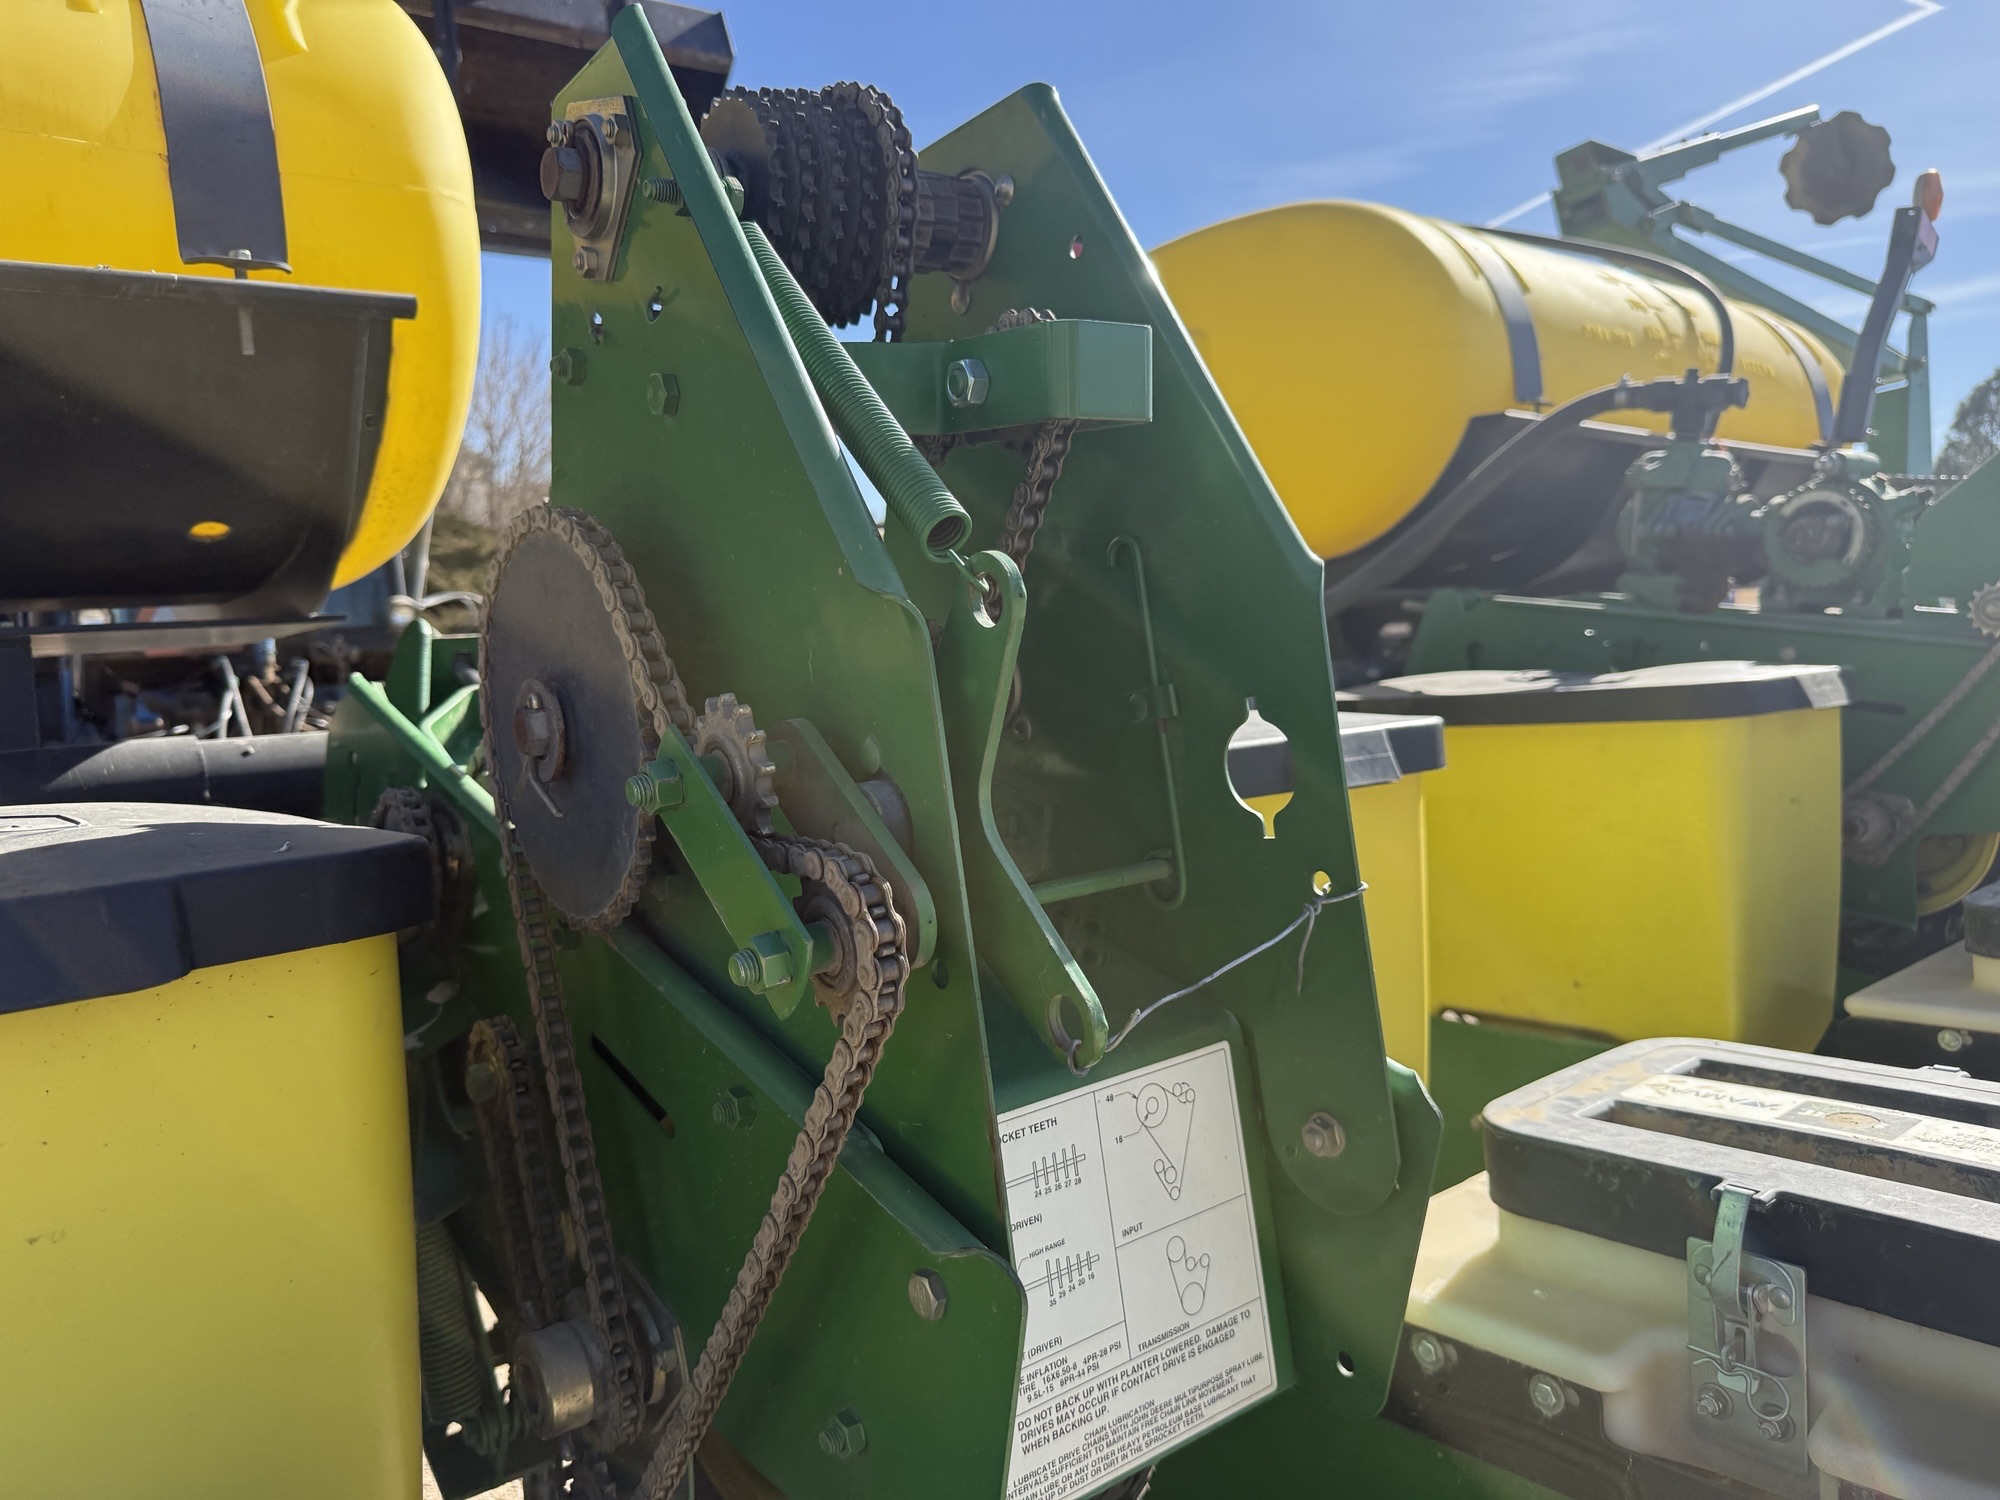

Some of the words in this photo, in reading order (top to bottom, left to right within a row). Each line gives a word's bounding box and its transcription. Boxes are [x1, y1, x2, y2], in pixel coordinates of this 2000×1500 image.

[1106, 1094, 1114, 1102] 48
[1002, 1128, 1026, 1143] CKET
[1028, 1117, 1057, 1134] TEETH
[1116, 1135, 1123, 1144] 18
[1034, 1190, 1042, 1198] 24
[1055, 1183, 1062, 1191] 26
[1065, 1180, 1071, 1188] 27
[1074, 1177, 1082, 1185] 28
[1010, 1213, 1042, 1232] DRIVEN)
[1122, 1222, 1143, 1237] INPUT
[1029, 1247, 1044, 1258] HIGH
[1045, 1238, 1065, 1251] RANGE
[1050, 1299, 1057, 1307] 35
[1059, 1290, 1066, 1298] 29
[1068, 1284, 1075, 1292] 24
[1078, 1278, 1085, 1286] 20
[1088, 1272, 1094, 1280] 16
[1028, 1336, 1062, 1359] (DRIVER)
[1138, 1321, 1190, 1352] TRANSMISSION
[1018, 1418, 1032, 1432] DO
[1034, 1406, 1052, 1422] NOT
[1055, 1393, 1080, 1413] BACK
[1083, 1386, 1094, 1399] UP
[1097, 1374, 1118, 1391] WITH
[1120, 1354, 1158, 1380] PLANTER
[1160, 1334, 1202, 1360] LOWERED.
[1206, 1315, 1238, 1338] DAMAGE
[1241, 1309, 1250, 1320] TO
[1019, 1381, 1036, 1396] TIRE
[1043, 1362, 1077, 1384] 16X6.50-8
[1110, 1341, 1121, 1352] PSI
[1021, 1422, 1054, 1443] DRIVES
[1057, 1408, 1076, 1426] MAY
[1078, 1392, 1109, 1414] OCCUR
[1112, 1386, 1119, 1398] IF
[1121, 1365, 1160, 1392] CONTACT
[1163, 1352, 1186, 1372] DRIVE
[1188, 1348, 1196, 1359] IS
[1198, 1328, 1235, 1354] ENGAGED
[1027, 1356, 1068, 1382] INFLATION
[1027, 1384, 1054, 1402] 9.5L-15
[1060, 1369, 1085, 1386] 8PR-44
[1087, 1362, 1099, 1373] PSI
[1014, 1459, 1057, 1488] LUBRICATE
[1058, 1447, 1080, 1464] DRIVE
[1082, 1432, 1109, 1452] CHAINS
[1111, 1423, 1128, 1436] WITH
[1130, 1412, 1148, 1427] JOHN
[1150, 1399, 1172, 1416] DEERE
[1174, 1372, 1223, 1403] MULTIPURPOSE
[1225, 1361, 1245, 1377] SPRAY
[1022, 1434, 1050, 1455] WHEN
[1052, 1412, 1093, 1440] BACKING
[1095, 1405, 1109, 1418] UP.
[1040, 1479, 1060, 1496] LUBE
[1062, 1473, 1072, 1484] OR
[1075, 1463, 1089, 1477] ANY
[1091, 1450, 1115, 1467] OTHER
[1117, 1436, 1140, 1453] HEAVY
[1142, 1412, 1183, 1441] PETROLEUM
[1185, 1403, 1202, 1418] BASE
[1203, 1384, 1238, 1408] LUBRICANT
[1240, 1374, 1256, 1388] THAT
[1051, 1449, 1092, 1478] SUFFICIENT
[1095, 1445, 1104, 1455] TO
[1106, 1427, 1139, 1448] MAINTAIN
[1141, 1415, 1158, 1430] FREE
[1160, 1404, 1180, 1419] CHAIN
[1182, 1396, 1197, 1408] LINK
[1084, 1424, 1106, 1441] CHAIN
[1108, 1400, 1155, 1429] LUBRICATION
[1058, 1485, 1068, 1495] OF
[1070, 1473, 1089, 1489] DUST
[1091, 1467, 1102, 1477] OR
[1103, 1457, 1119, 1471] DIRT
[1121, 1453, 1128, 1461] IN
[1130, 1443, 1144, 1456] THE
[1144, 1424, 1180, 1448] SPROCKET
